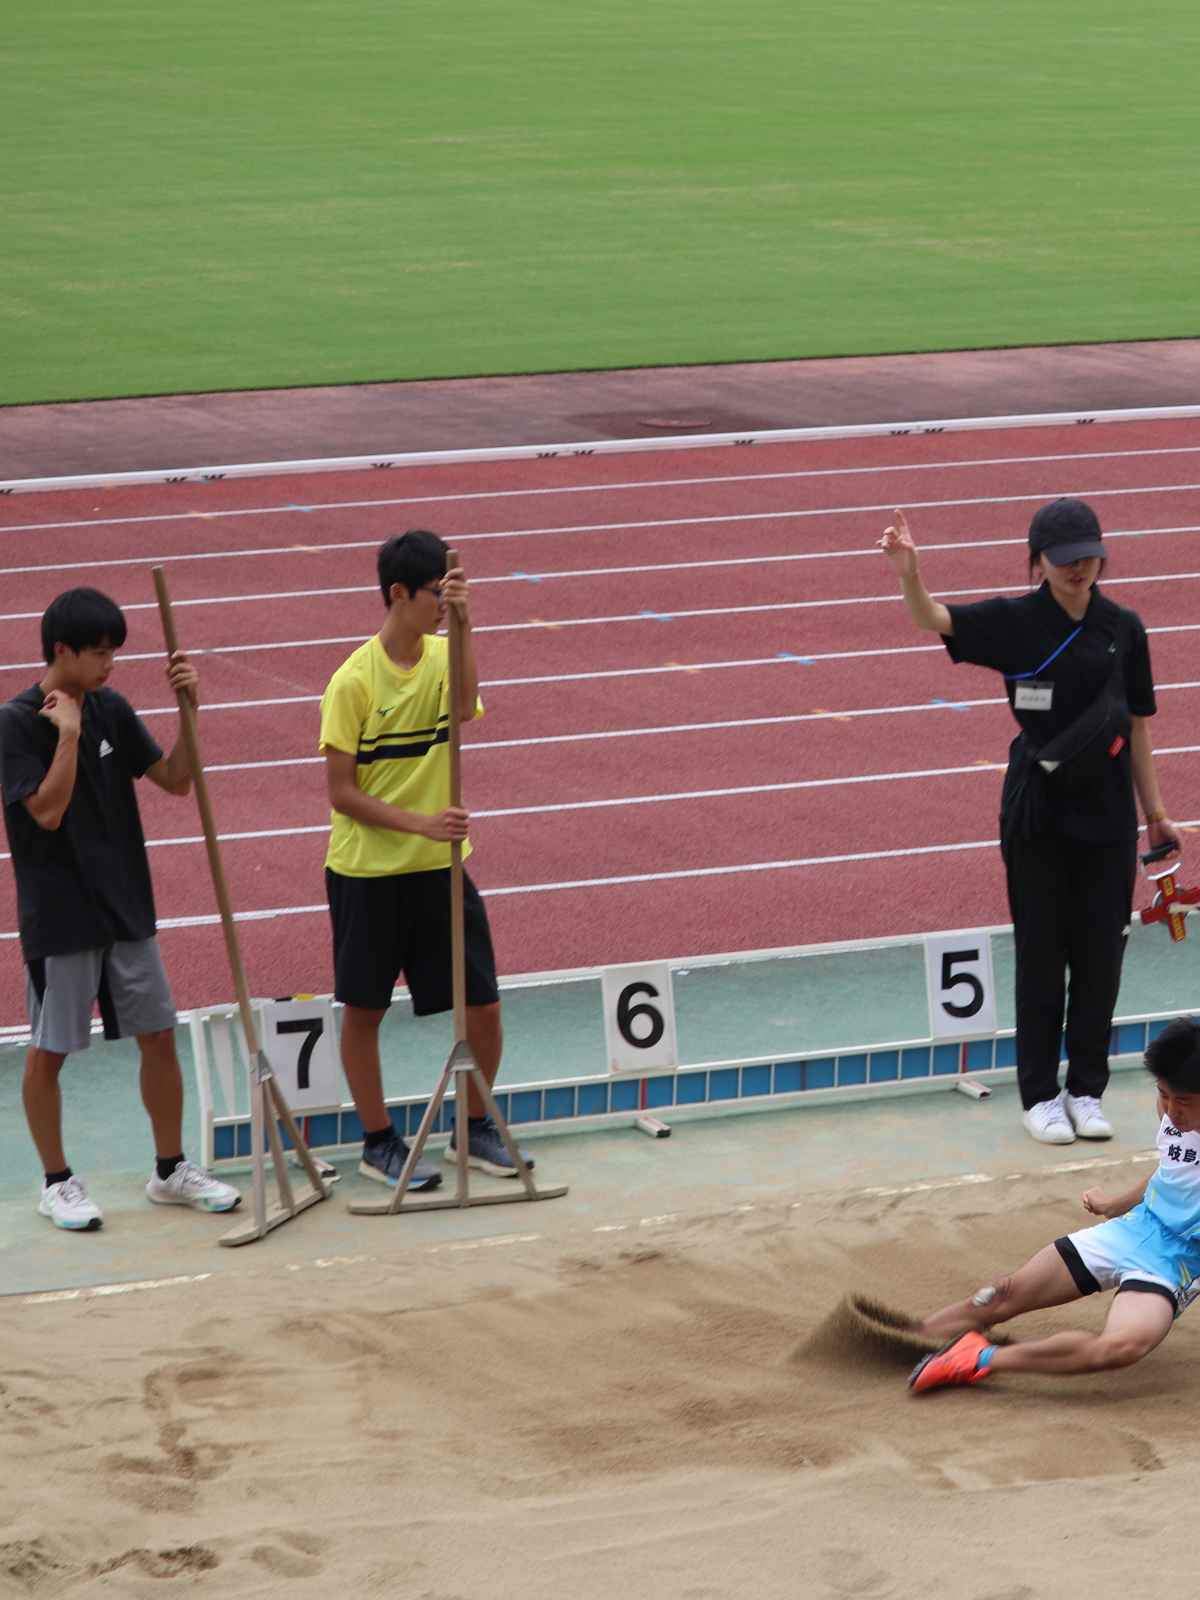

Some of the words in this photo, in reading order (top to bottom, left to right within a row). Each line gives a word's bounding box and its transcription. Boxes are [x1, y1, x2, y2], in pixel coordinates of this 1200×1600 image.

[617, 981, 664, 1048] 6
[941, 948, 985, 1019] 5
[276, 1016, 324, 1090] 7
